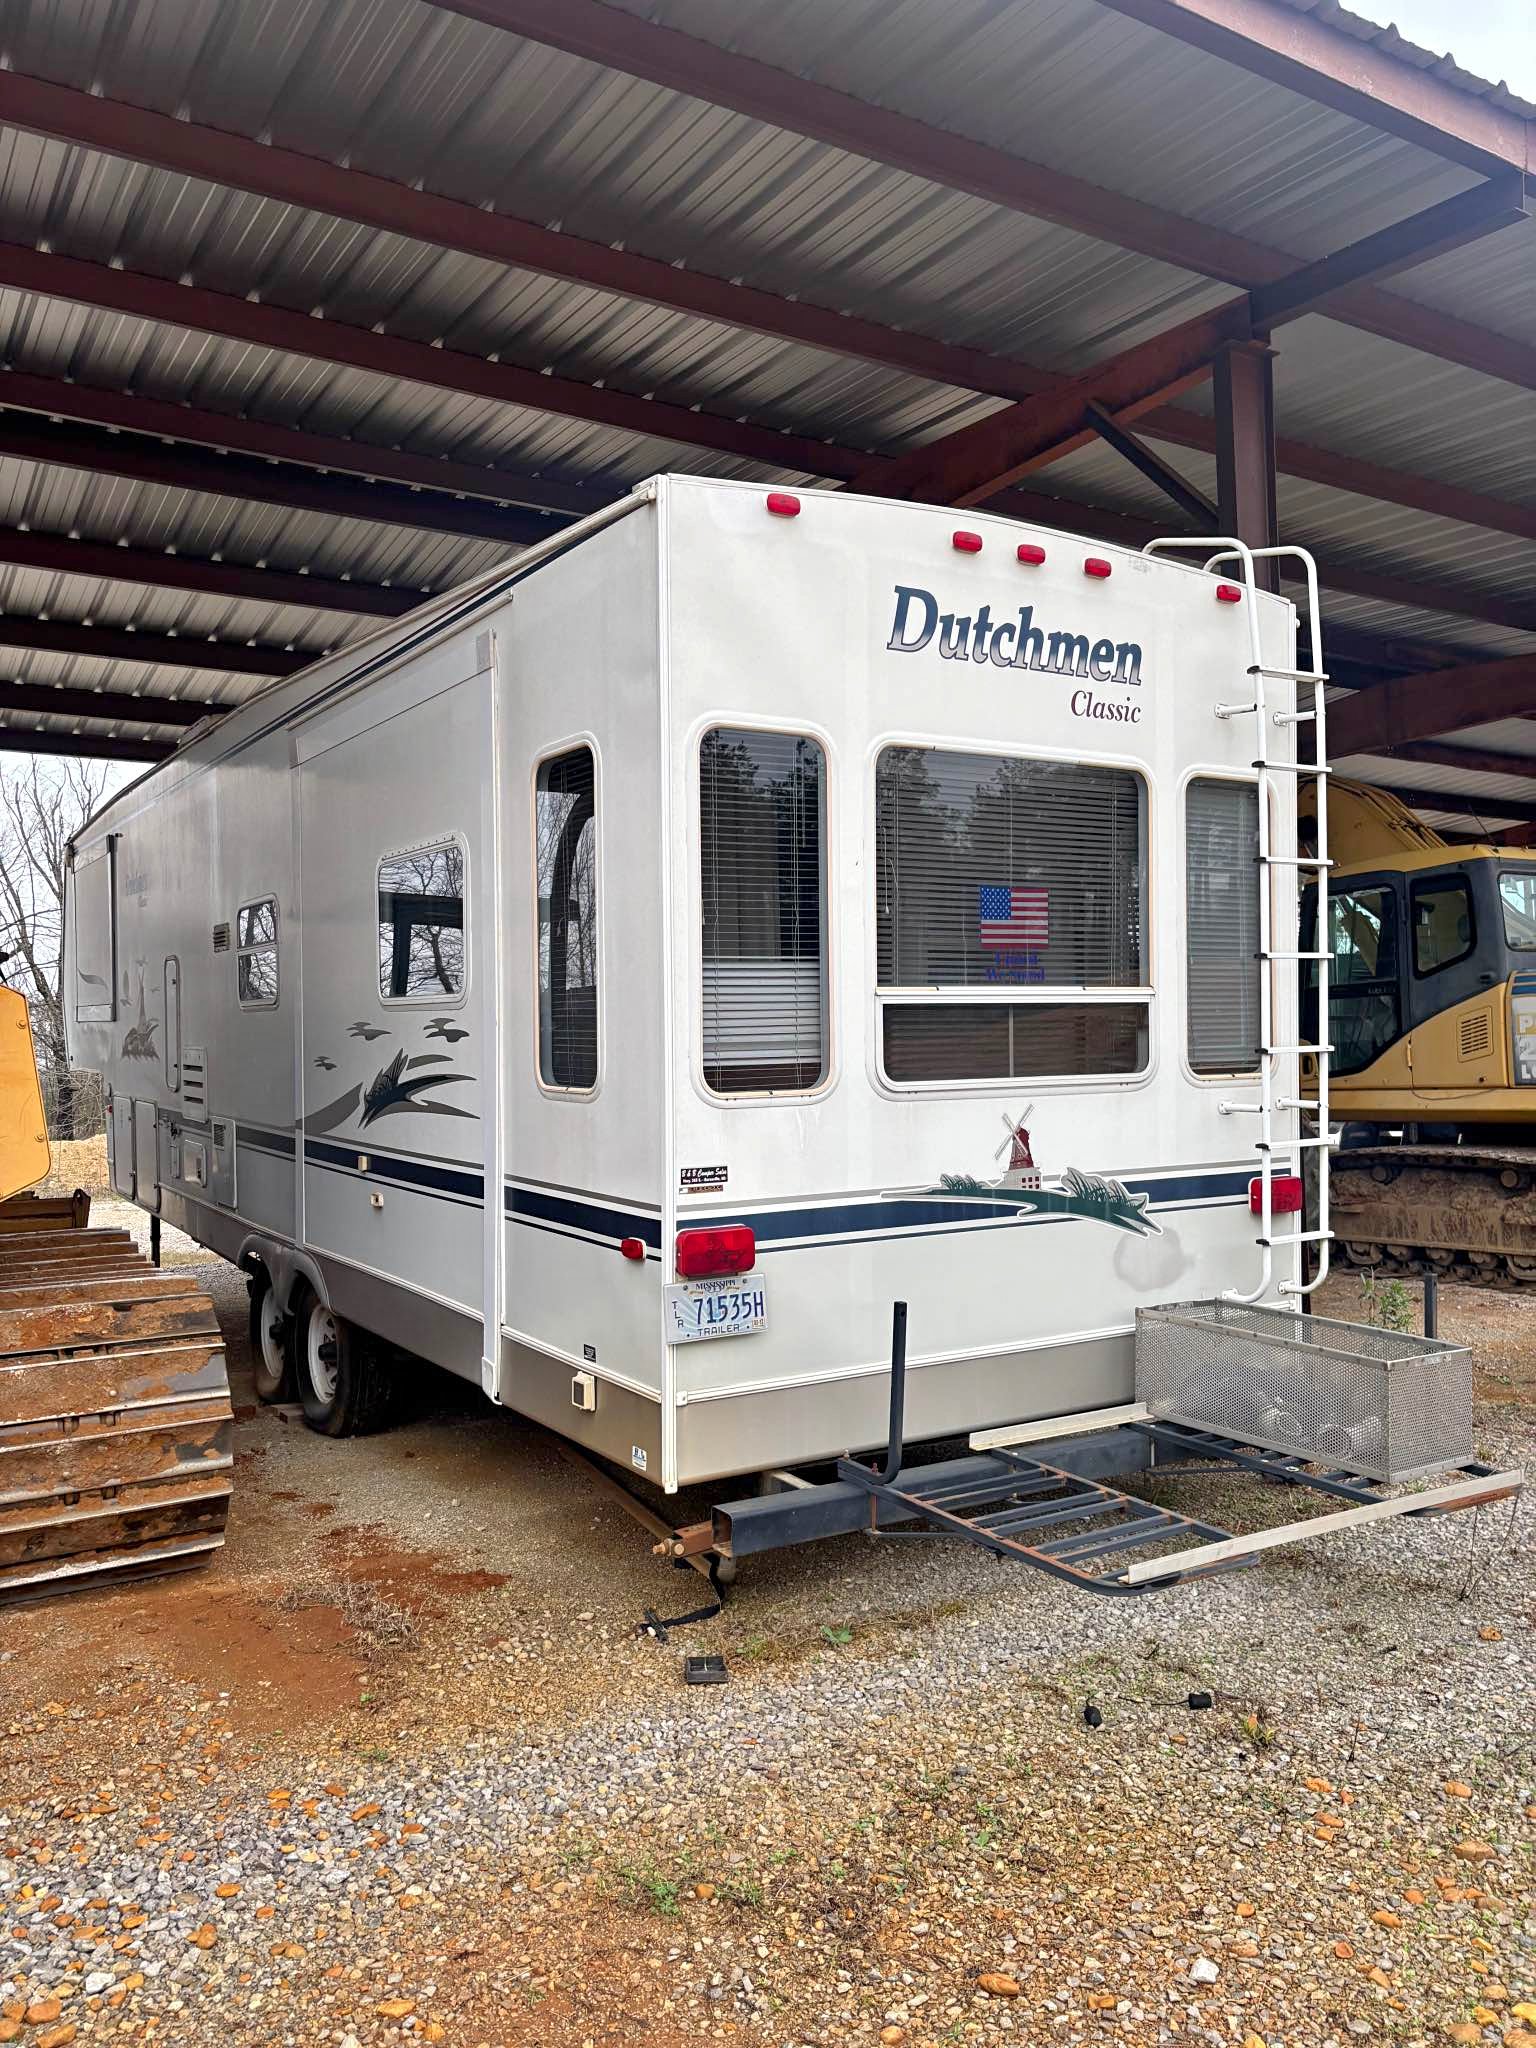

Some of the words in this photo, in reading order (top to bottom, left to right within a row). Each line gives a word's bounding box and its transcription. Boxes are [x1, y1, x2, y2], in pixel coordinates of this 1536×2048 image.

[887, 585, 1142, 685] Dutchmen
[1071, 690, 1141, 723] Classic
[695, 1279, 736, 1293] MISSISSIPPI
[693, 1291, 764, 1325] 71535H
[698, 1324, 740, 1336] TRAILER
